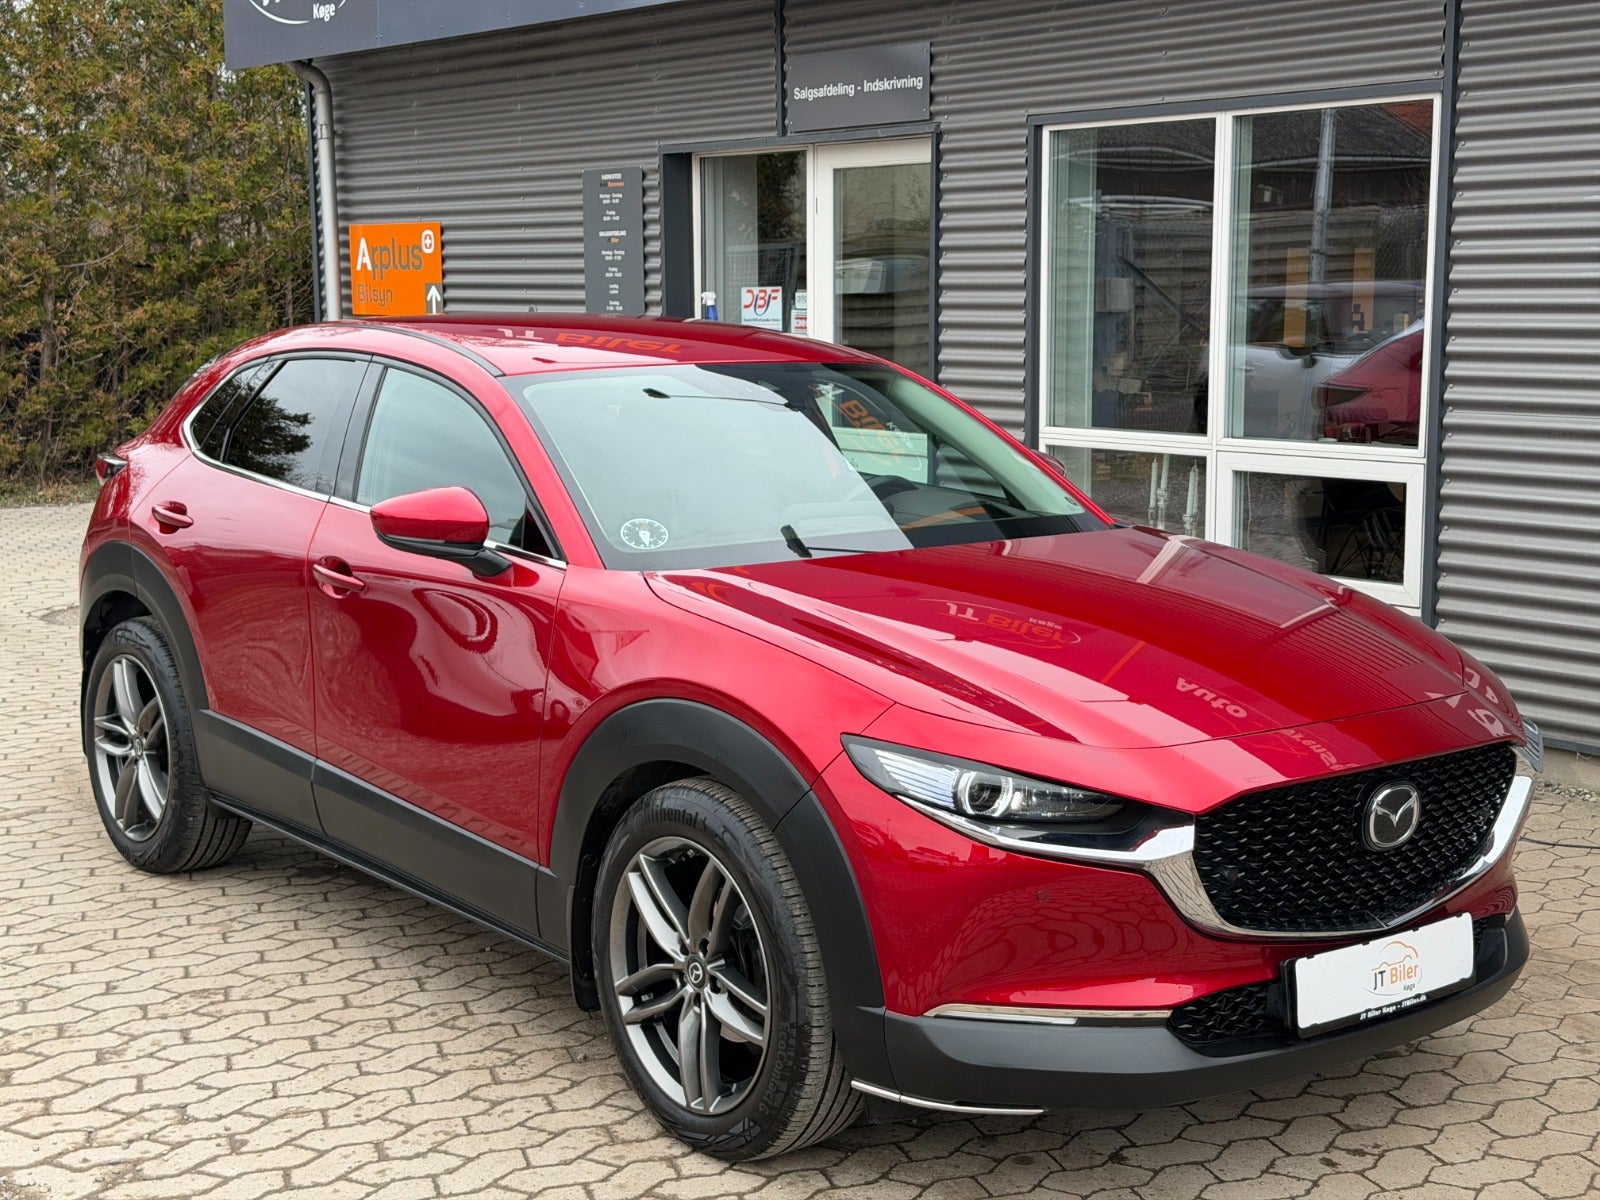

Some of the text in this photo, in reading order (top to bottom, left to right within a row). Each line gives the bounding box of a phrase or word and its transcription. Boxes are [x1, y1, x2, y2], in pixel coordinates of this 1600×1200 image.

[313, 3, 336, 22] Køge
[793, 83, 855, 101] Salgsafdeling
[863, 75, 923, 92] Indskrivning
[358, 284, 393, 307] Bilsyn
[1373, 964, 1419, 991] JT Biler
